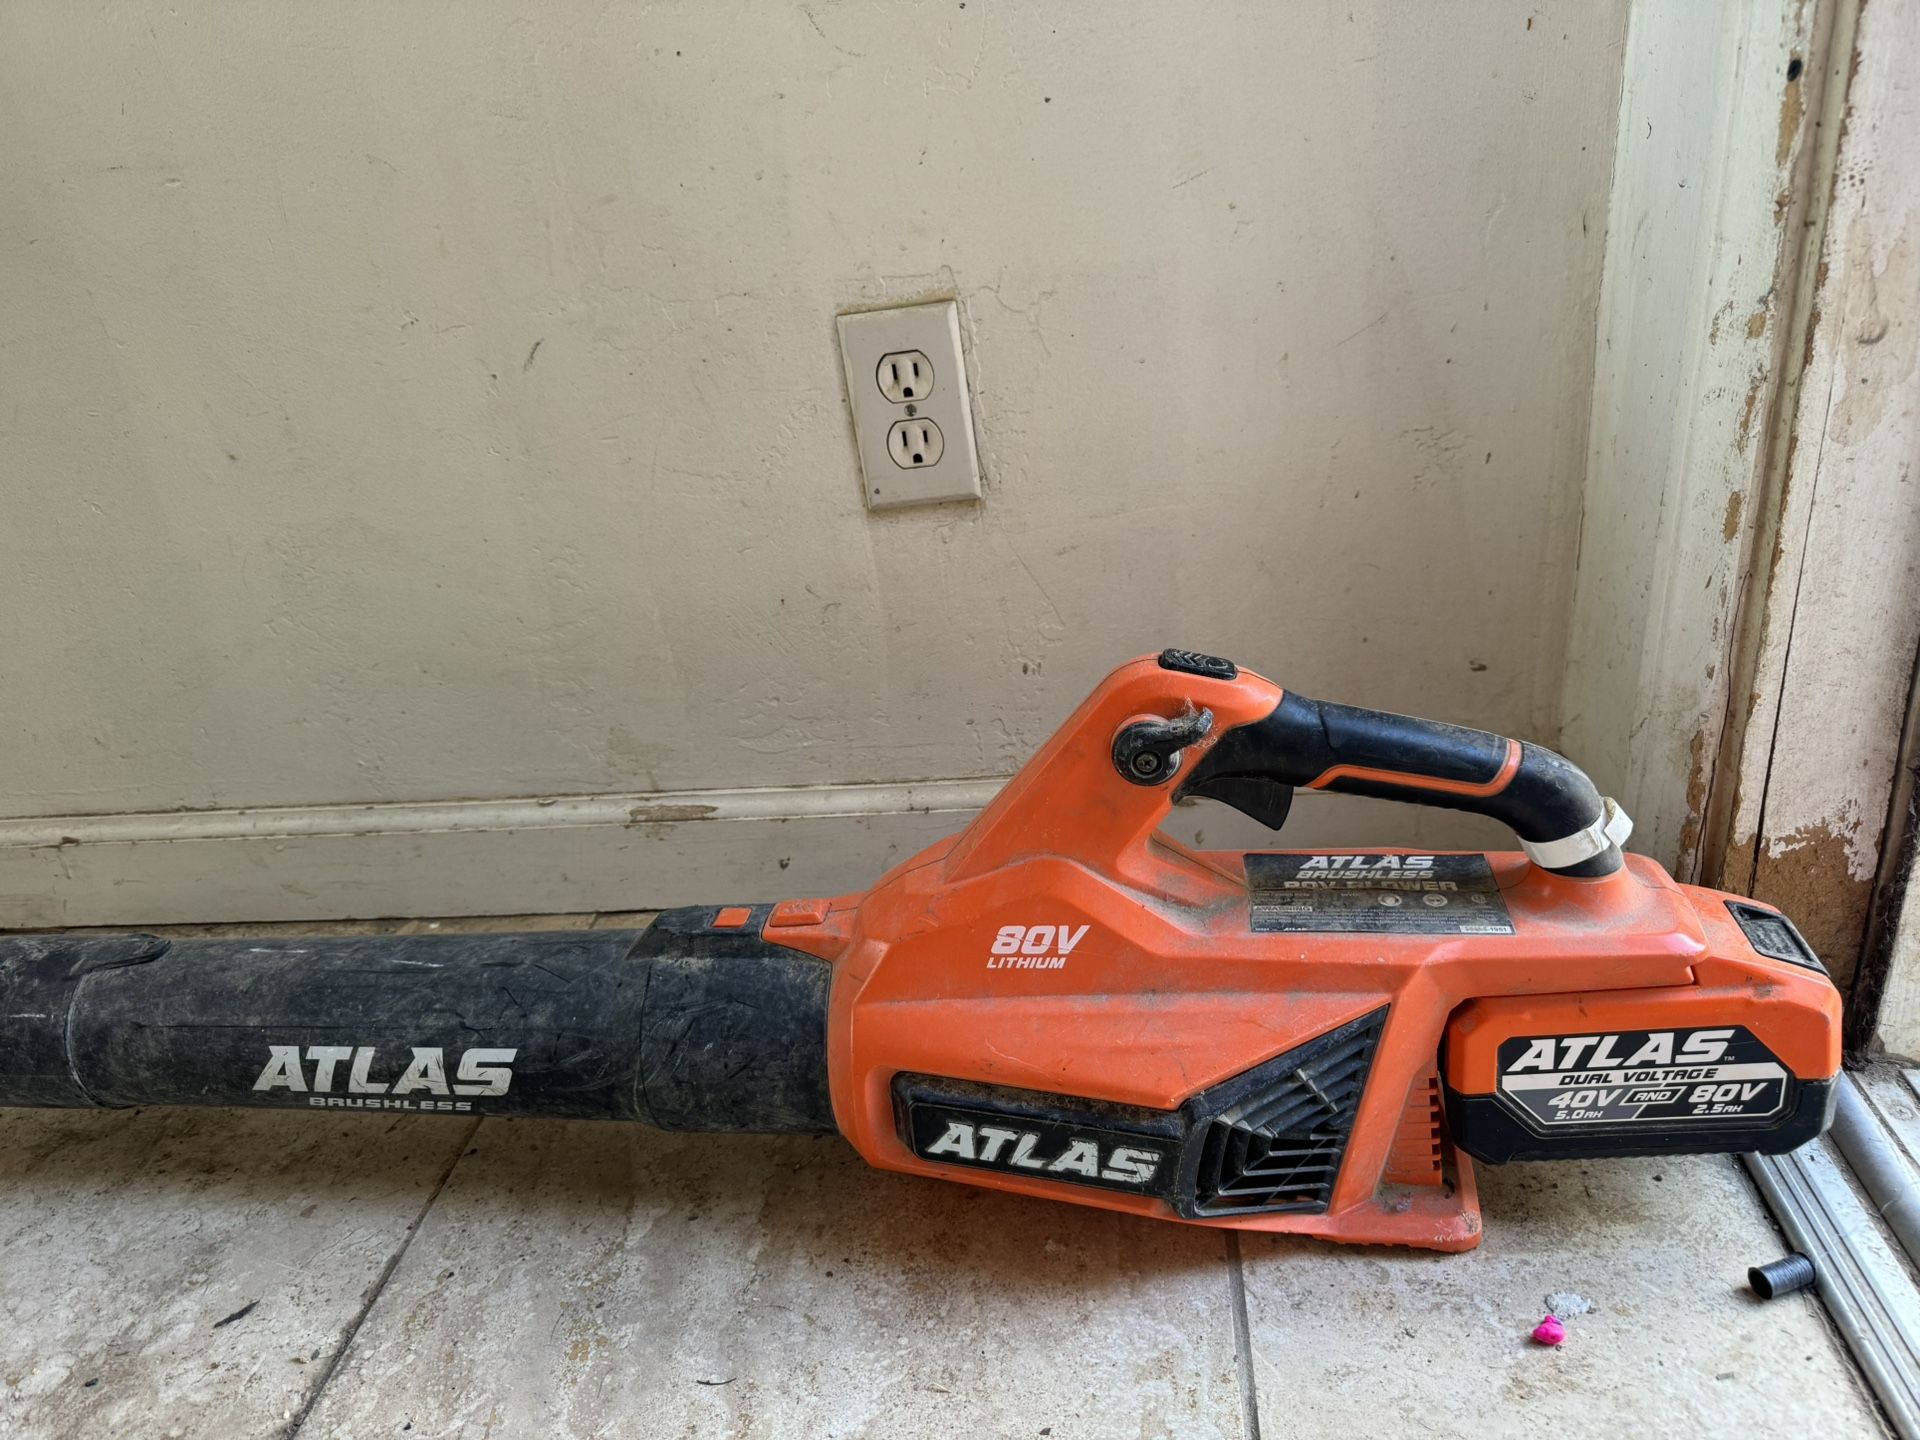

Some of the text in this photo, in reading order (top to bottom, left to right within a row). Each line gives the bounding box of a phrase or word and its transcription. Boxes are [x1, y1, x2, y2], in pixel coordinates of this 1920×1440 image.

[1300, 855, 1435, 869] ATLAS
[1295, 870, 1434, 879] BRUSHLESS
[990, 925, 1091, 954] 80V
[986, 957, 1067, 969] LITHIUM
[1506, 1029, 1736, 1072] ATLAS
[252, 1045, 518, 1096] ATLAS
[1559, 1068, 1719, 1086] DUAL VOLTAGE
[309, 1096, 472, 1111] BRUSHLESS
[1548, 1082, 1769, 1109] 40V AND 80V
[927, 1122, 1161, 1183] ATLAS
